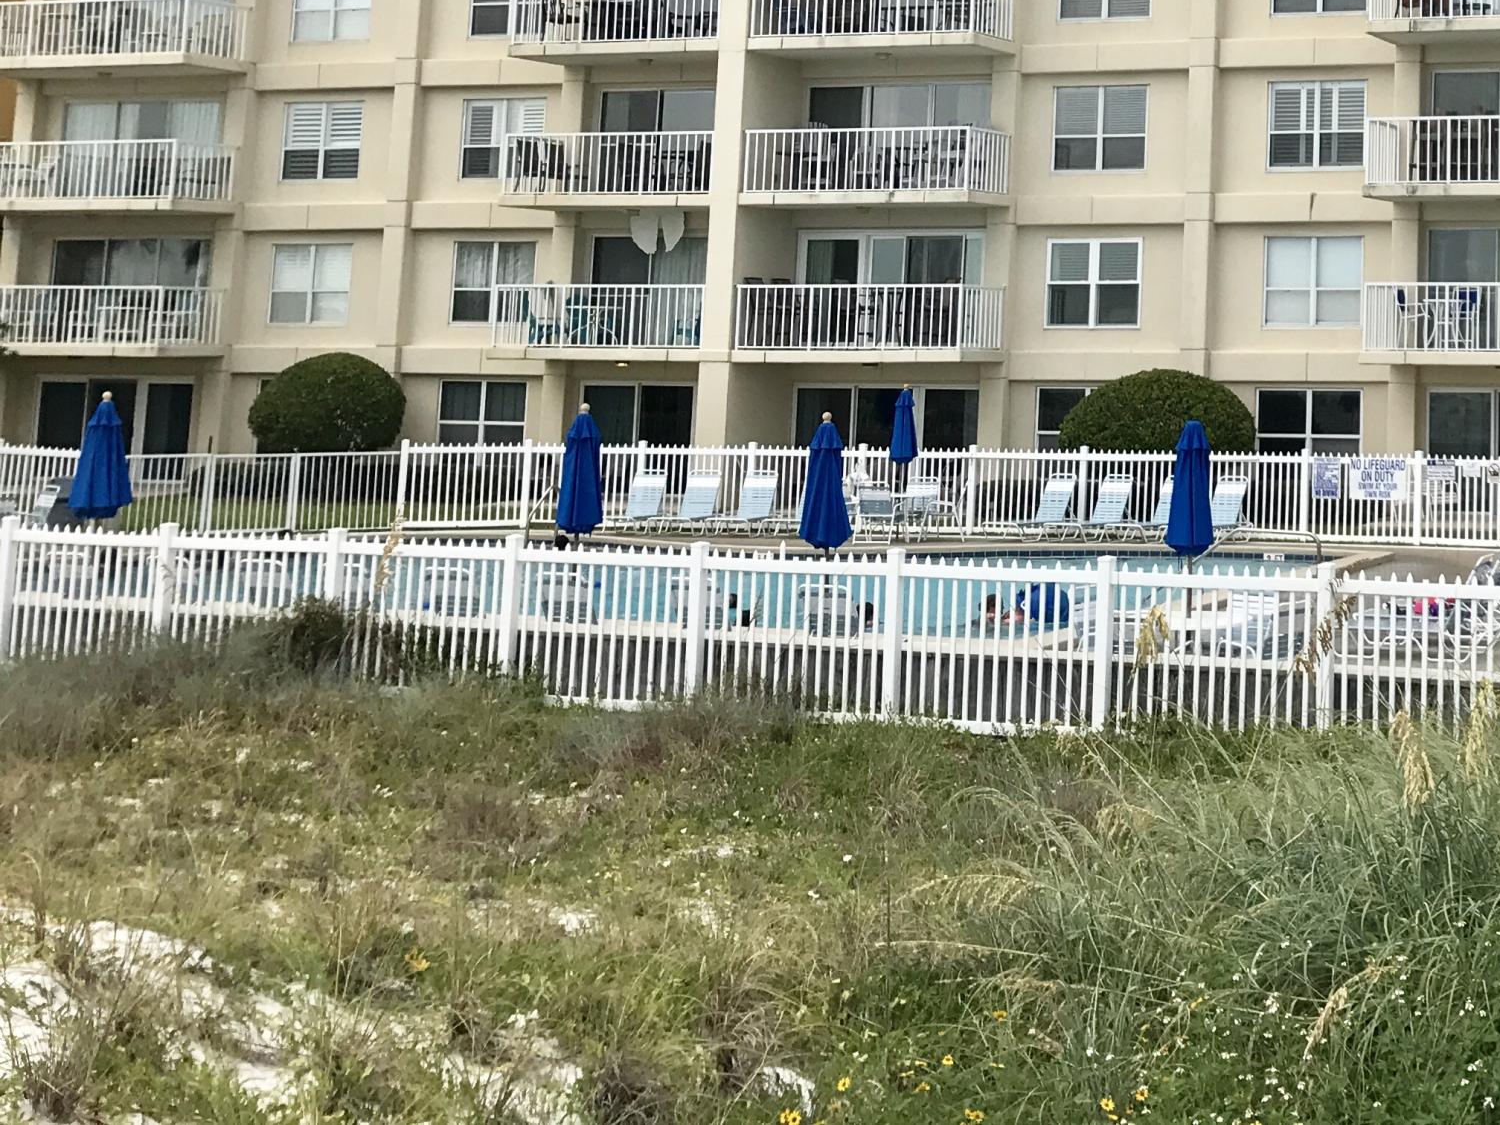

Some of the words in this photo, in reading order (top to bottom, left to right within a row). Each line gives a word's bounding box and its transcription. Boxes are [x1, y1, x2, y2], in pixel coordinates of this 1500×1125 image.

[1350, 458, 1361, 470] NO
[1364, 458, 1405, 471] LIFEGUARD
[1361, 470, 1372, 482] ON
[1374, 470, 1395, 482] DUTY
[1358, 482, 1373, 490] SWIM
[1375, 482, 1381, 490] AT
[1383, 482, 1397, 490] YOUR
[1364, 490, 1377, 498] OWN
[1378, 490, 1391, 498] RISK
